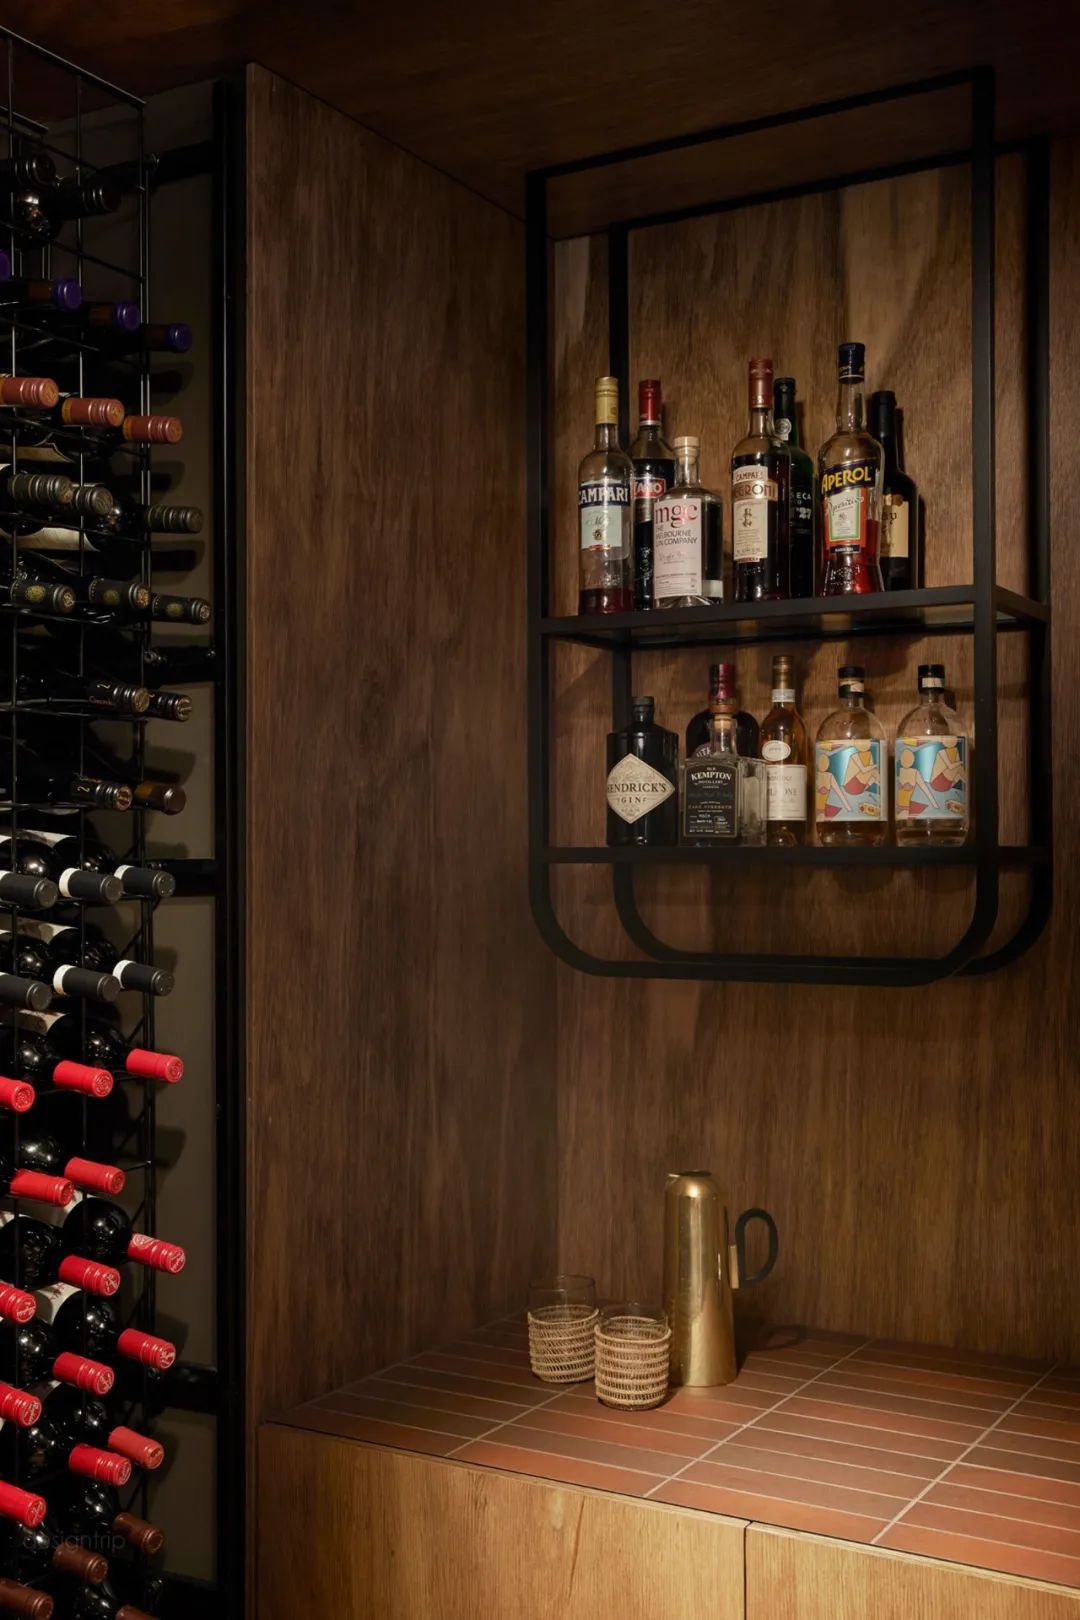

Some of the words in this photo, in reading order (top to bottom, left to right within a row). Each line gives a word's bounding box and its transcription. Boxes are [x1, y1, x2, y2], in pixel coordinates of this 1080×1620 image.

[821, 466, 871, 492] APEROL
[664, 537, 698, 546] COMPANY
[691, 771, 732, 781] KEMPTON
[621, 796, 641, 804] GIN
